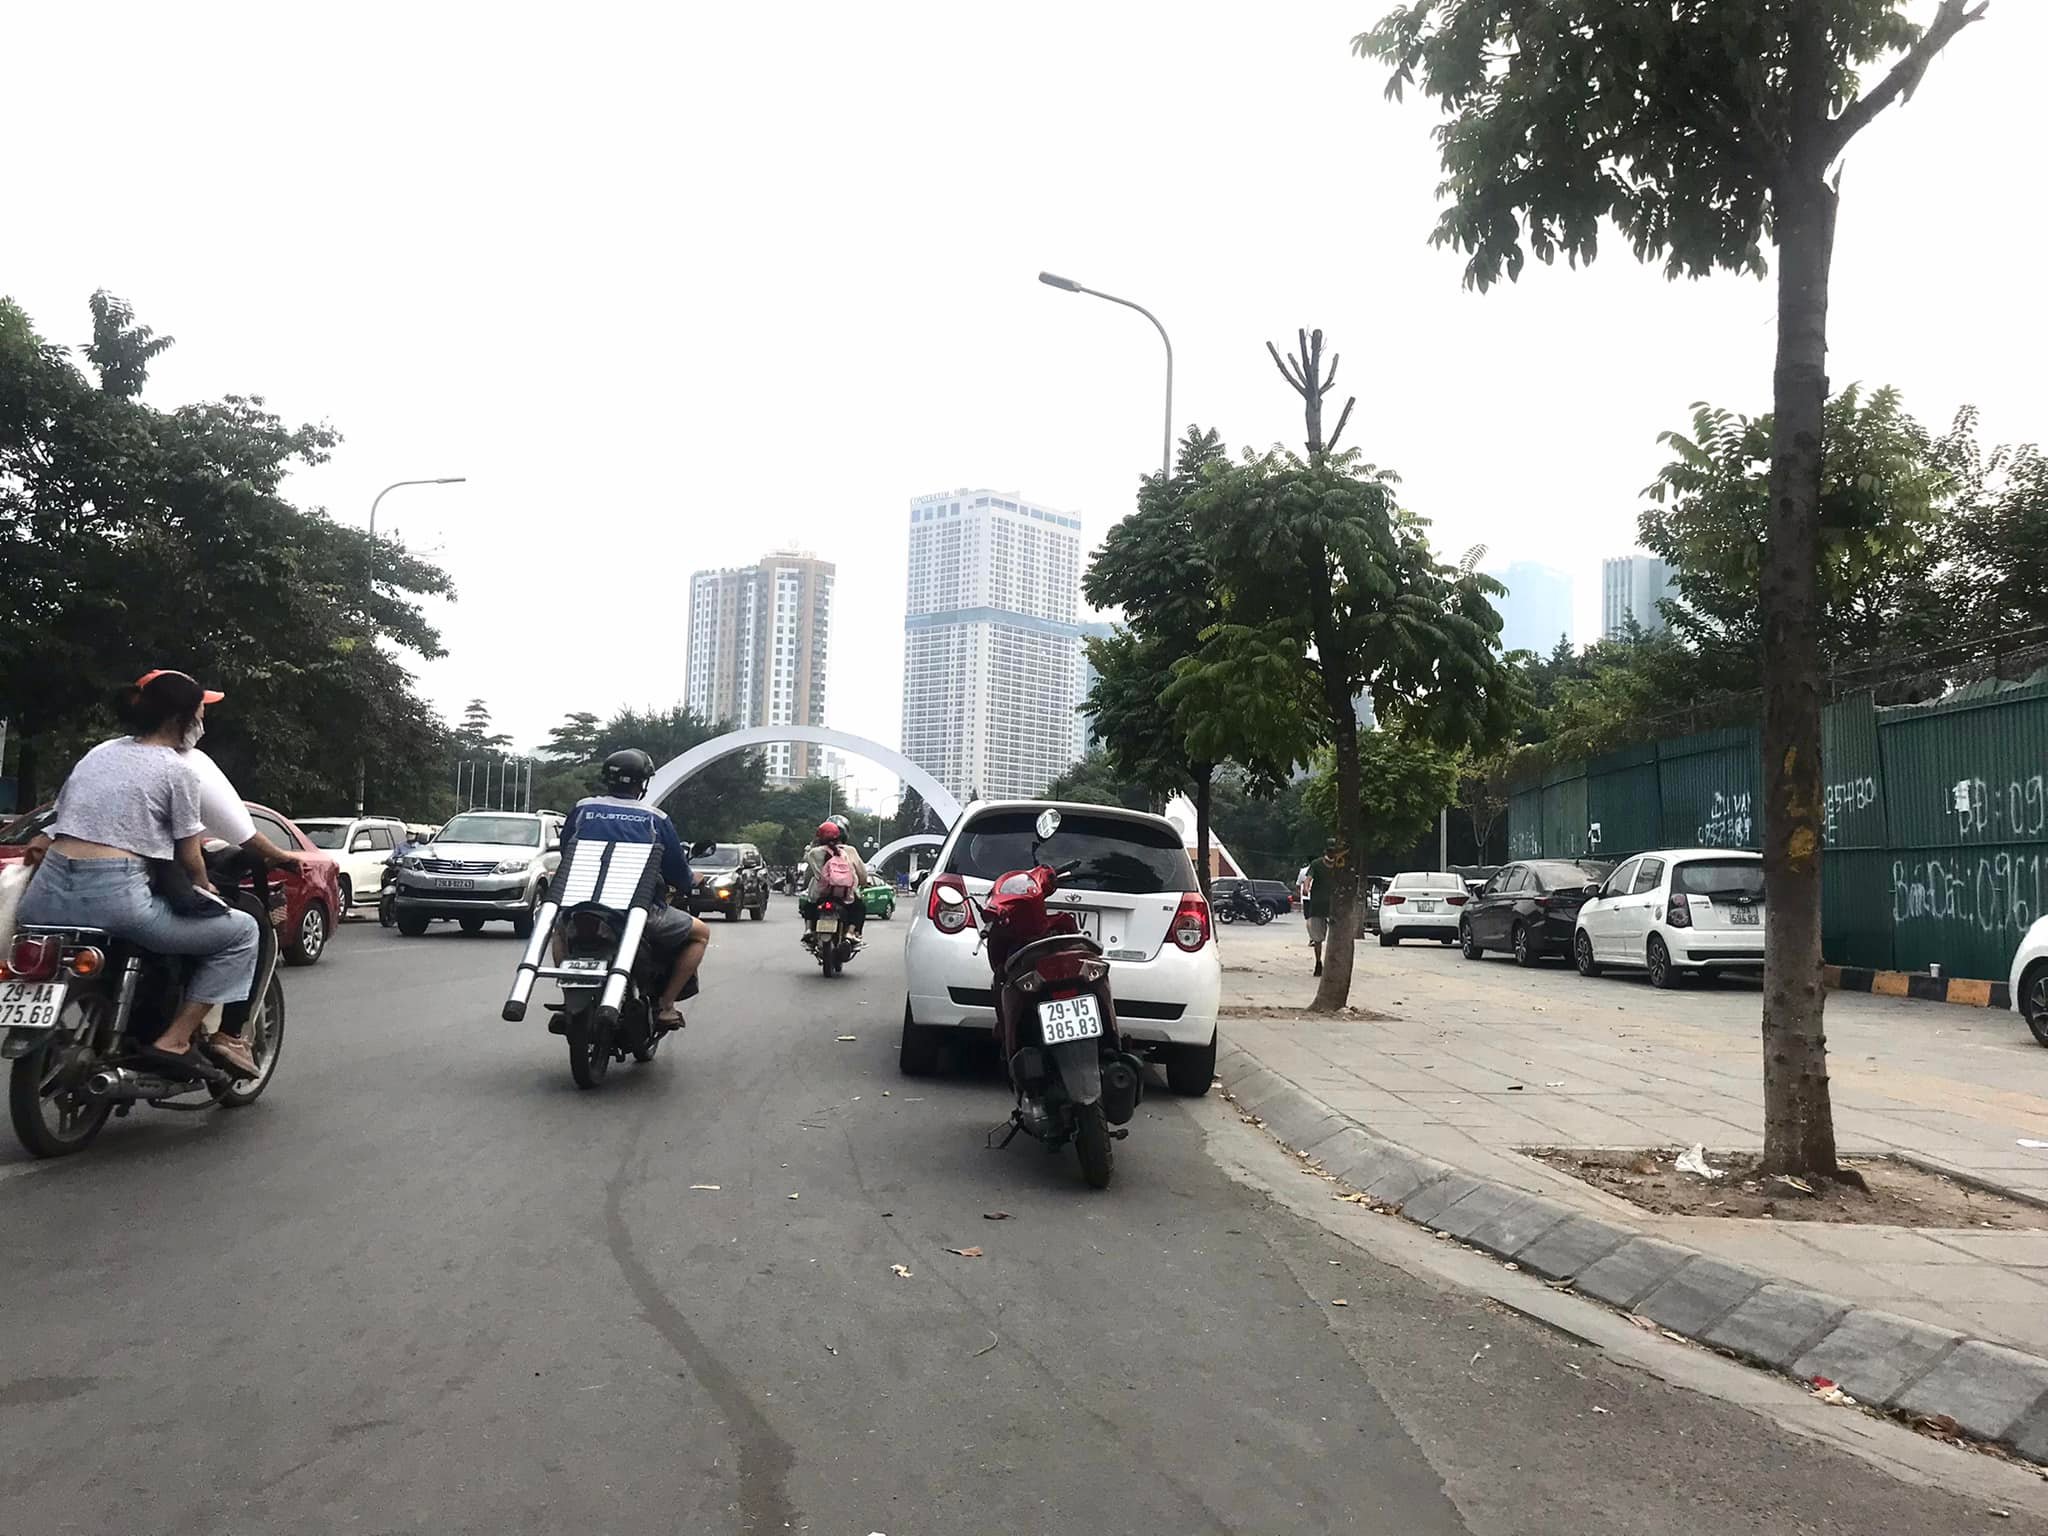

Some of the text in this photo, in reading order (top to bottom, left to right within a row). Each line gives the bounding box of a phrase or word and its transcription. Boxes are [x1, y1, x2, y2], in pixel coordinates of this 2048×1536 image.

[3, 983, 54, 1003] 29-AA
[0, 1004, 54, 1025] 75.68
[1047, 998, 1090, 1022] 29-V5
[1046, 1016, 1099, 1041] 385.83
